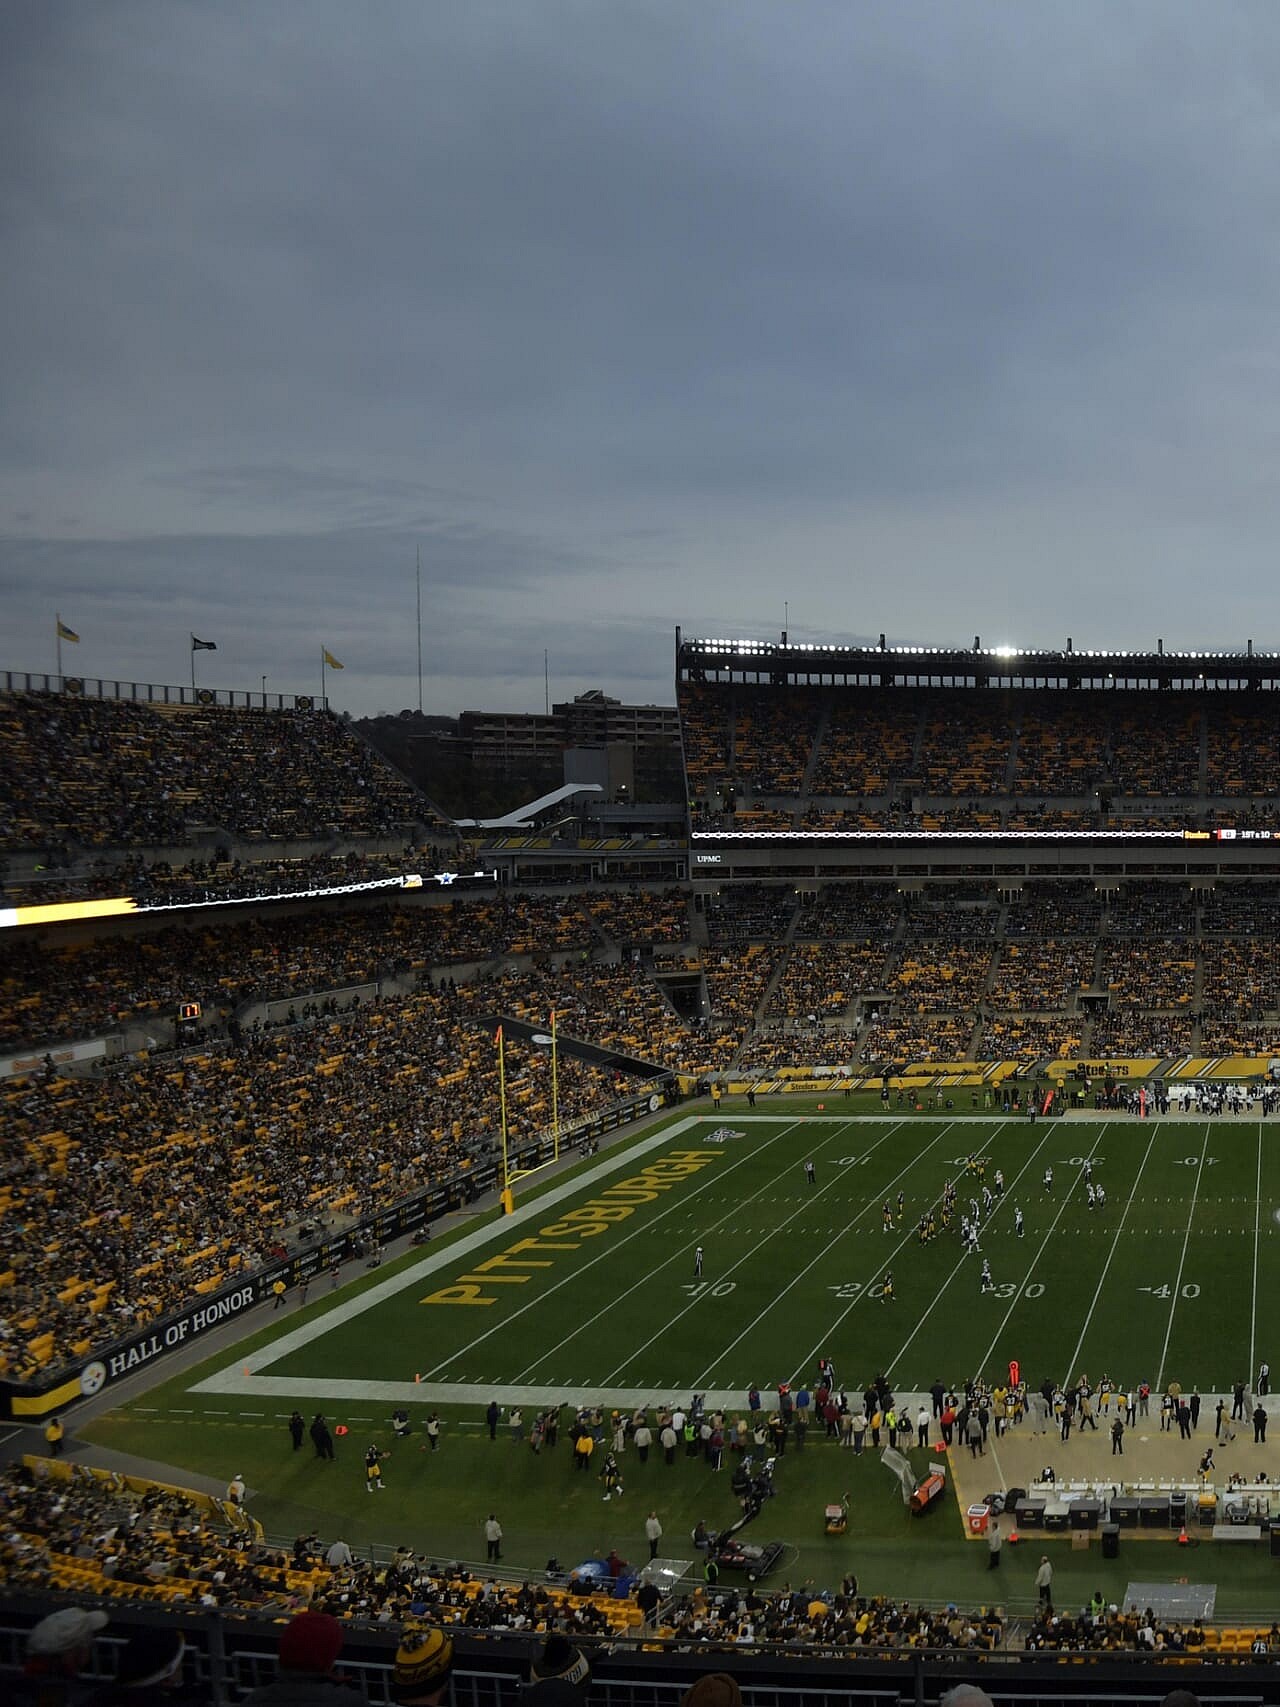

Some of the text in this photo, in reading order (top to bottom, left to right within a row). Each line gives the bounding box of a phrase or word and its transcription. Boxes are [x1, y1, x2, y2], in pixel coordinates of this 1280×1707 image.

[697, 855, 721, 863] UPMC
[419, 1151, 726, 1305] PITTSBURGH
[687, 1282, 736, 1296] 10
[994, 1284, 1045, 1298] 30
[1152, 1284, 1200, 1299] 40
[110, 1286, 254, 1377] HALL OF HONOR
